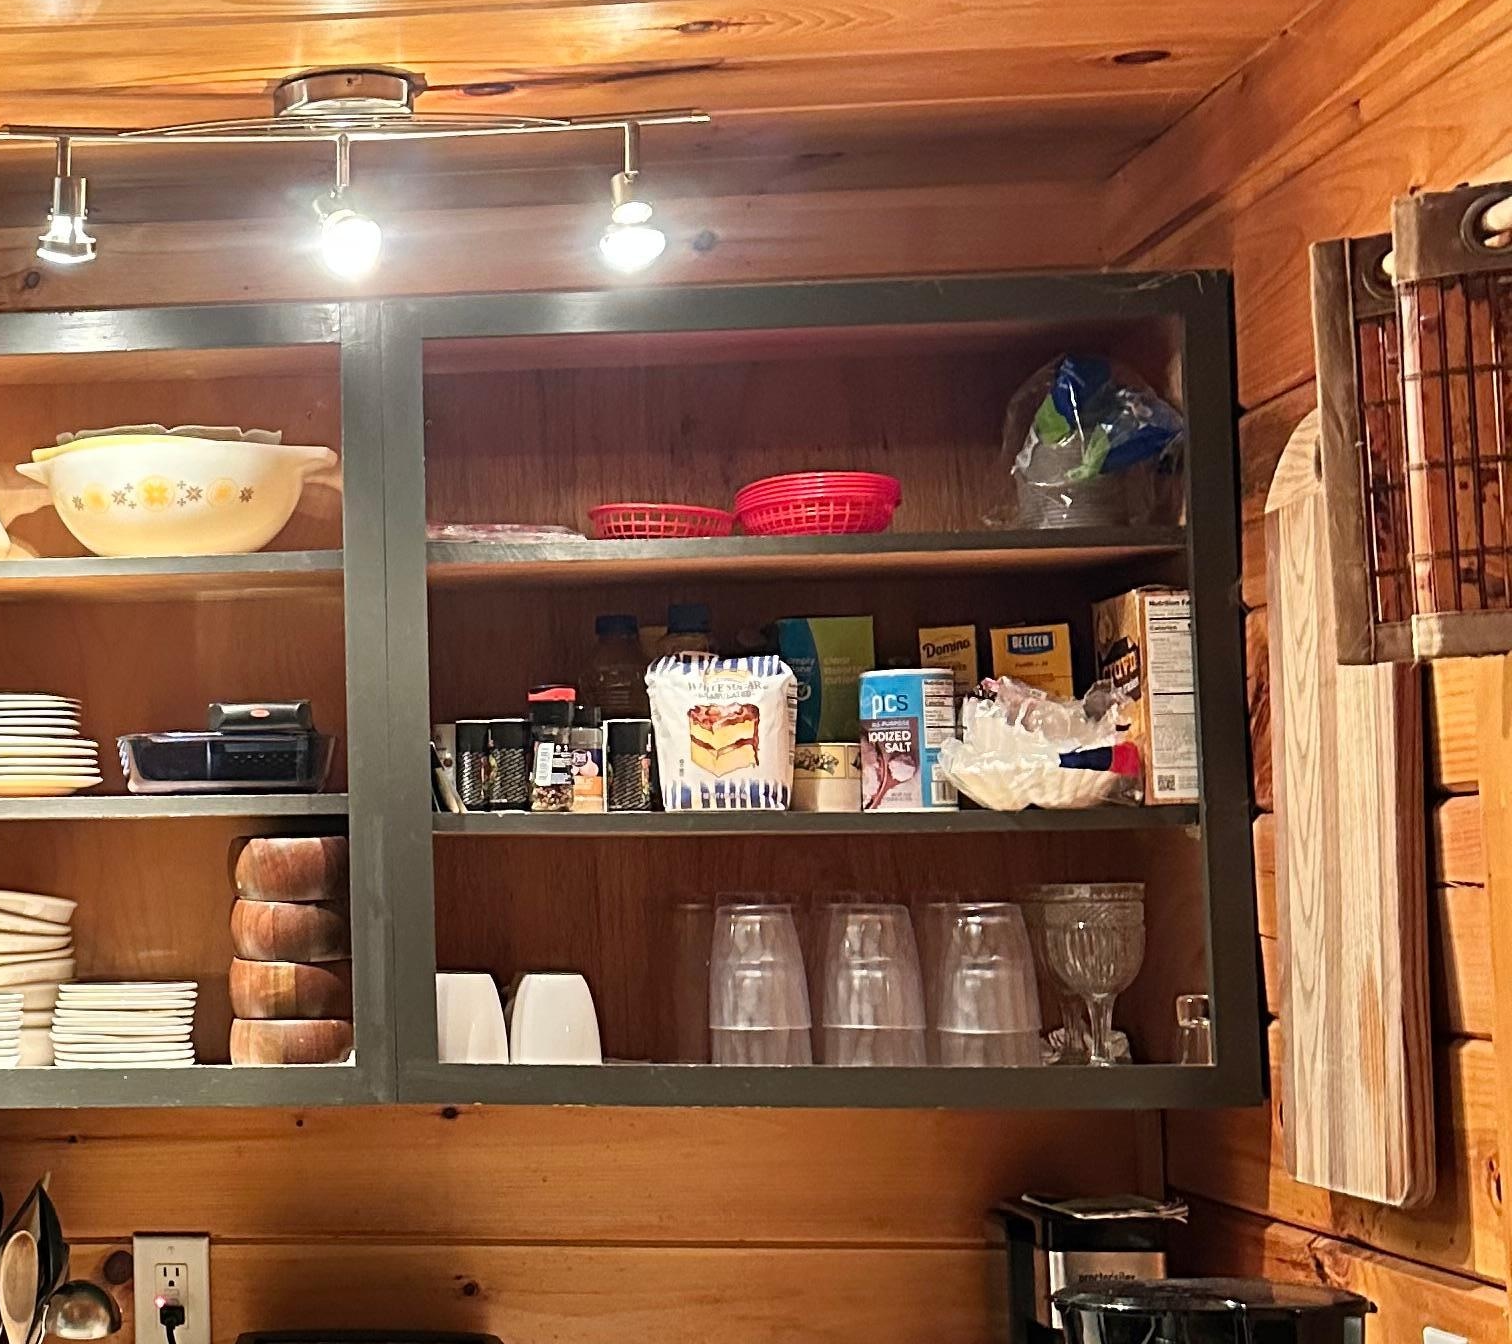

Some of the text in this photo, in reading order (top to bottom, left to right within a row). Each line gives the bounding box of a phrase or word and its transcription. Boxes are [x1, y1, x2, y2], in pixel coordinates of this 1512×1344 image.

[922, 639, 970, 659] Domino
[868, 730, 912, 743] IODIZED
[885, 742, 912, 754] SALT
